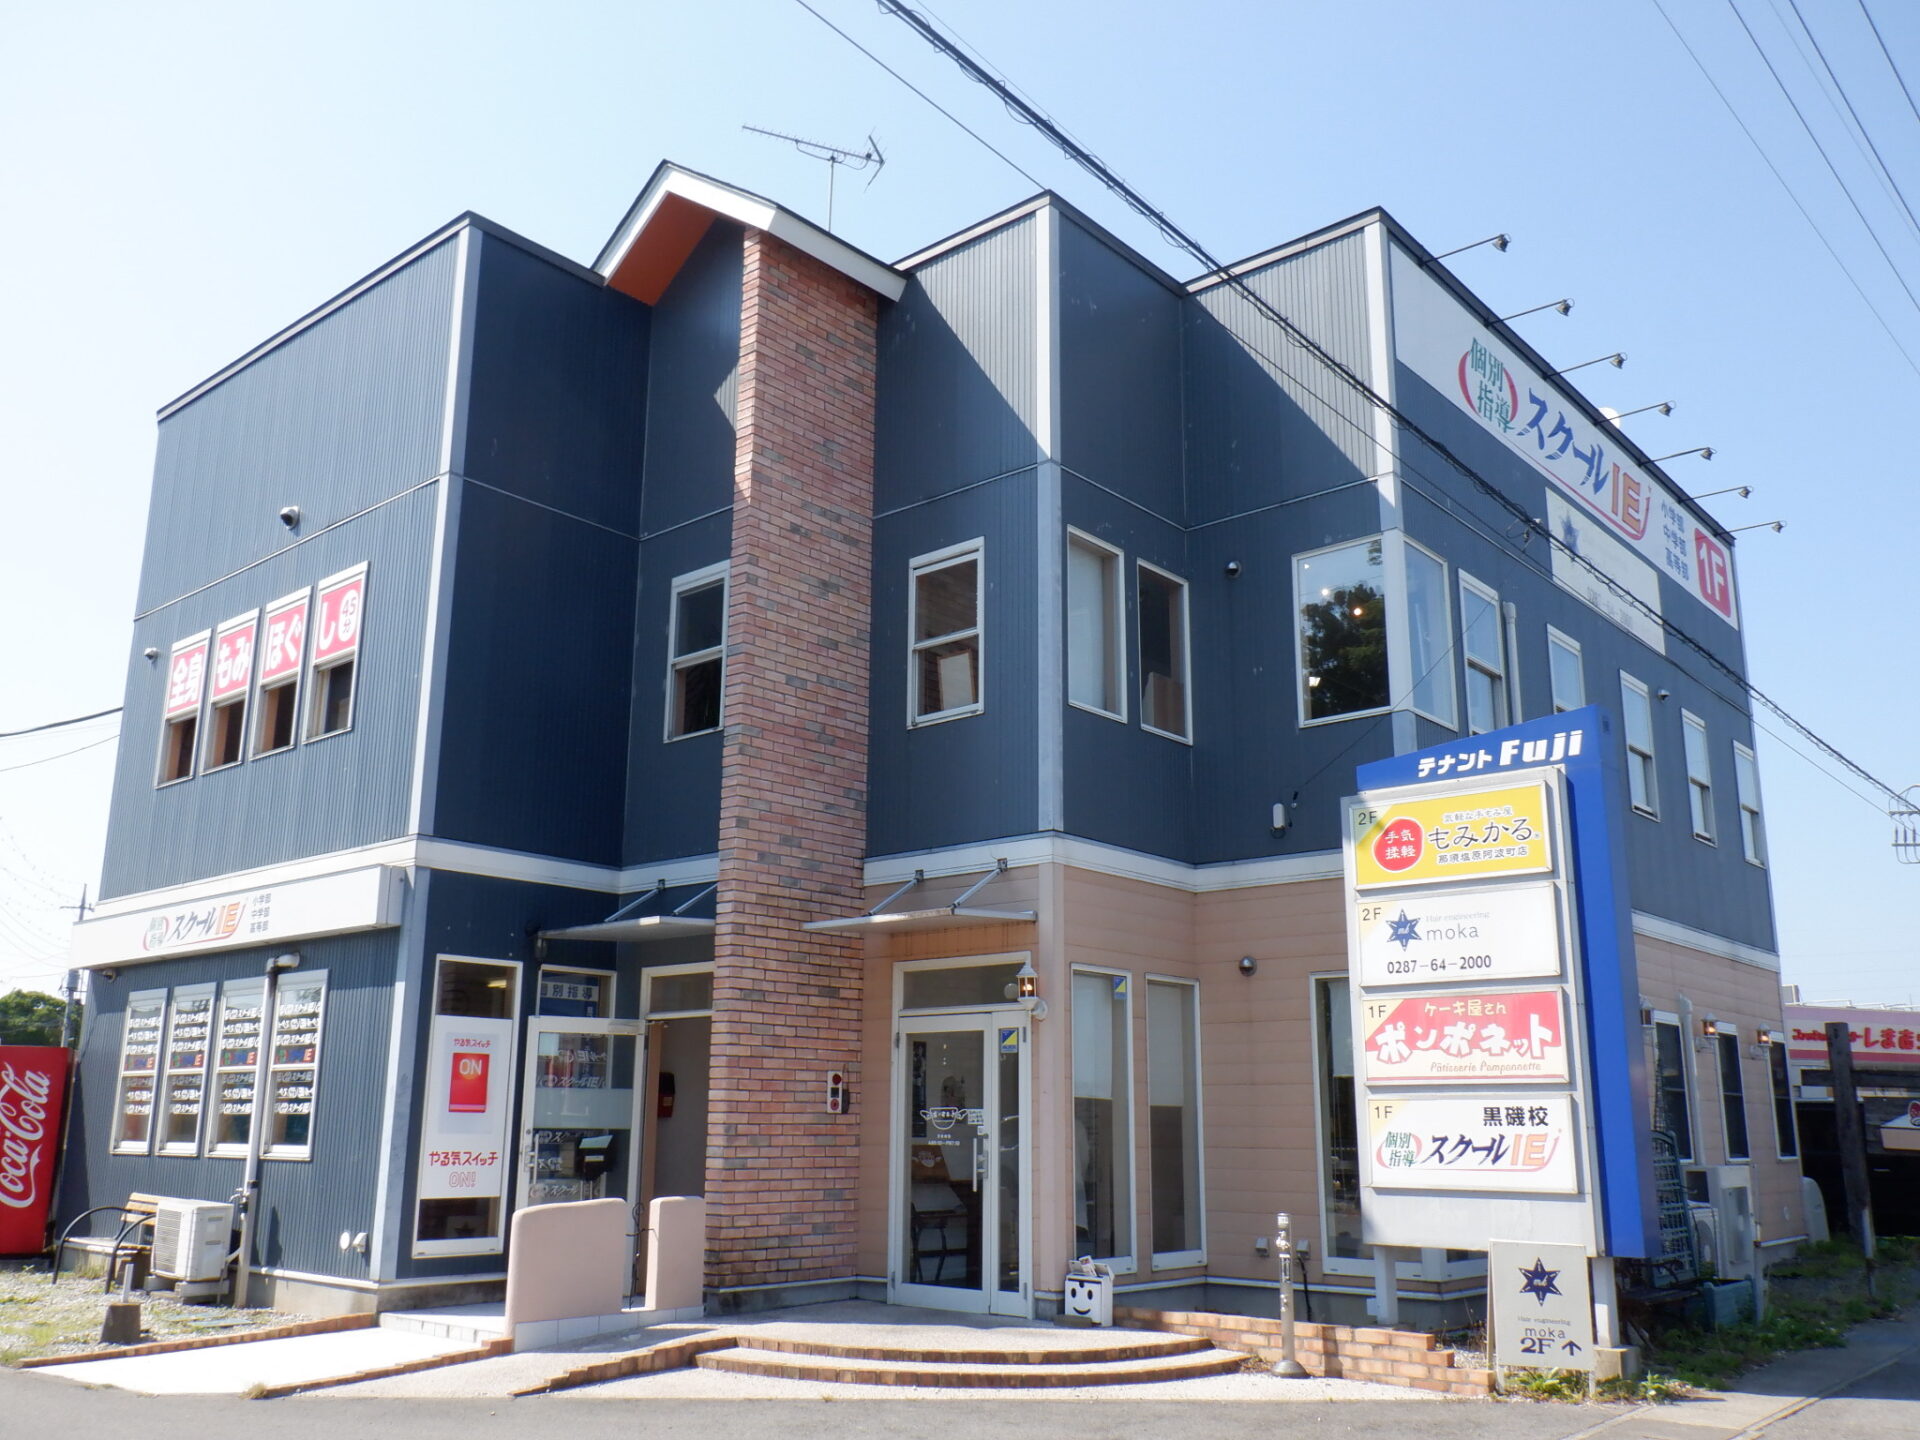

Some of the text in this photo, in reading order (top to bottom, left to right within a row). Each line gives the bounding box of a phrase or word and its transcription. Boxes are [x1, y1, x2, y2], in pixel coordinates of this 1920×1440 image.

[1470, 337, 1504, 392] 個別
[1477, 380, 1515, 433] 指導
[1516, 387, 1641, 534] スクールIE
[1699, 541, 1724, 601] 1F
[1417, 730, 1583, 778] テナント Fuji
[1358, 811, 1378, 826] 2F
[1428, 818, 1532, 850] もみかる
[1362, 908, 1382, 921] 2F
[1426, 923, 1479, 941] moka
[1387, 955, 1492, 974] 0287-64-2000
[1368, 1005, 1387, 1018] 1F
[1424, 999, 1507, 1016] ケーキ屋さん
[1375, 1013, 1553, 1064] ポンポネット
[459, 1059, 482, 1075] ON
[1374, 1106, 1393, 1119] 1F
[1483, 1106, 1549, 1126] 黒磯校
[1385, 1131, 1413, 1148] 個別
[1421, 1133, 1548, 1166] スクールIE
[429, 1151, 498, 1166] やる気スイッチ
[1388, 1151, 1416, 1168] 指導
[1525, 1327, 1566, 1339] moka
[1521, 1337, 1555, 1354] 2F
